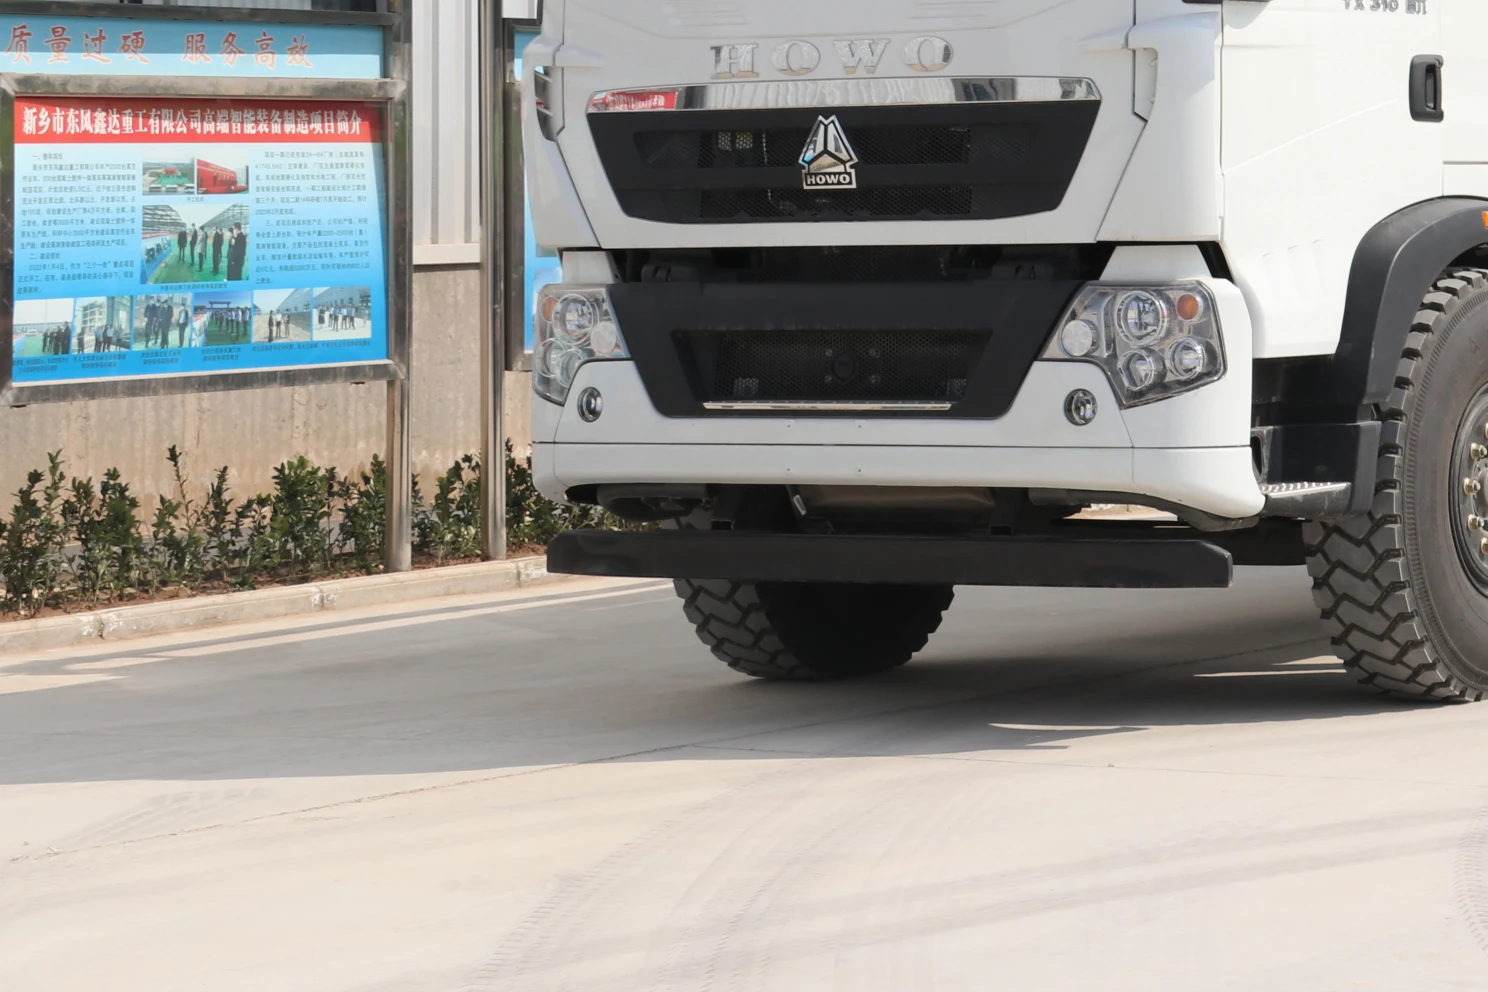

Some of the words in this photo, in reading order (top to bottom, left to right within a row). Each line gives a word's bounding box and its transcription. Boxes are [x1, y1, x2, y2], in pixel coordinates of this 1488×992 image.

[3, 24, 151, 66] 质量过硬
[181, 30, 314, 68] 服务高效
[710, 35, 954, 79] HOWO
[806, 174, 851, 185] HOWO
